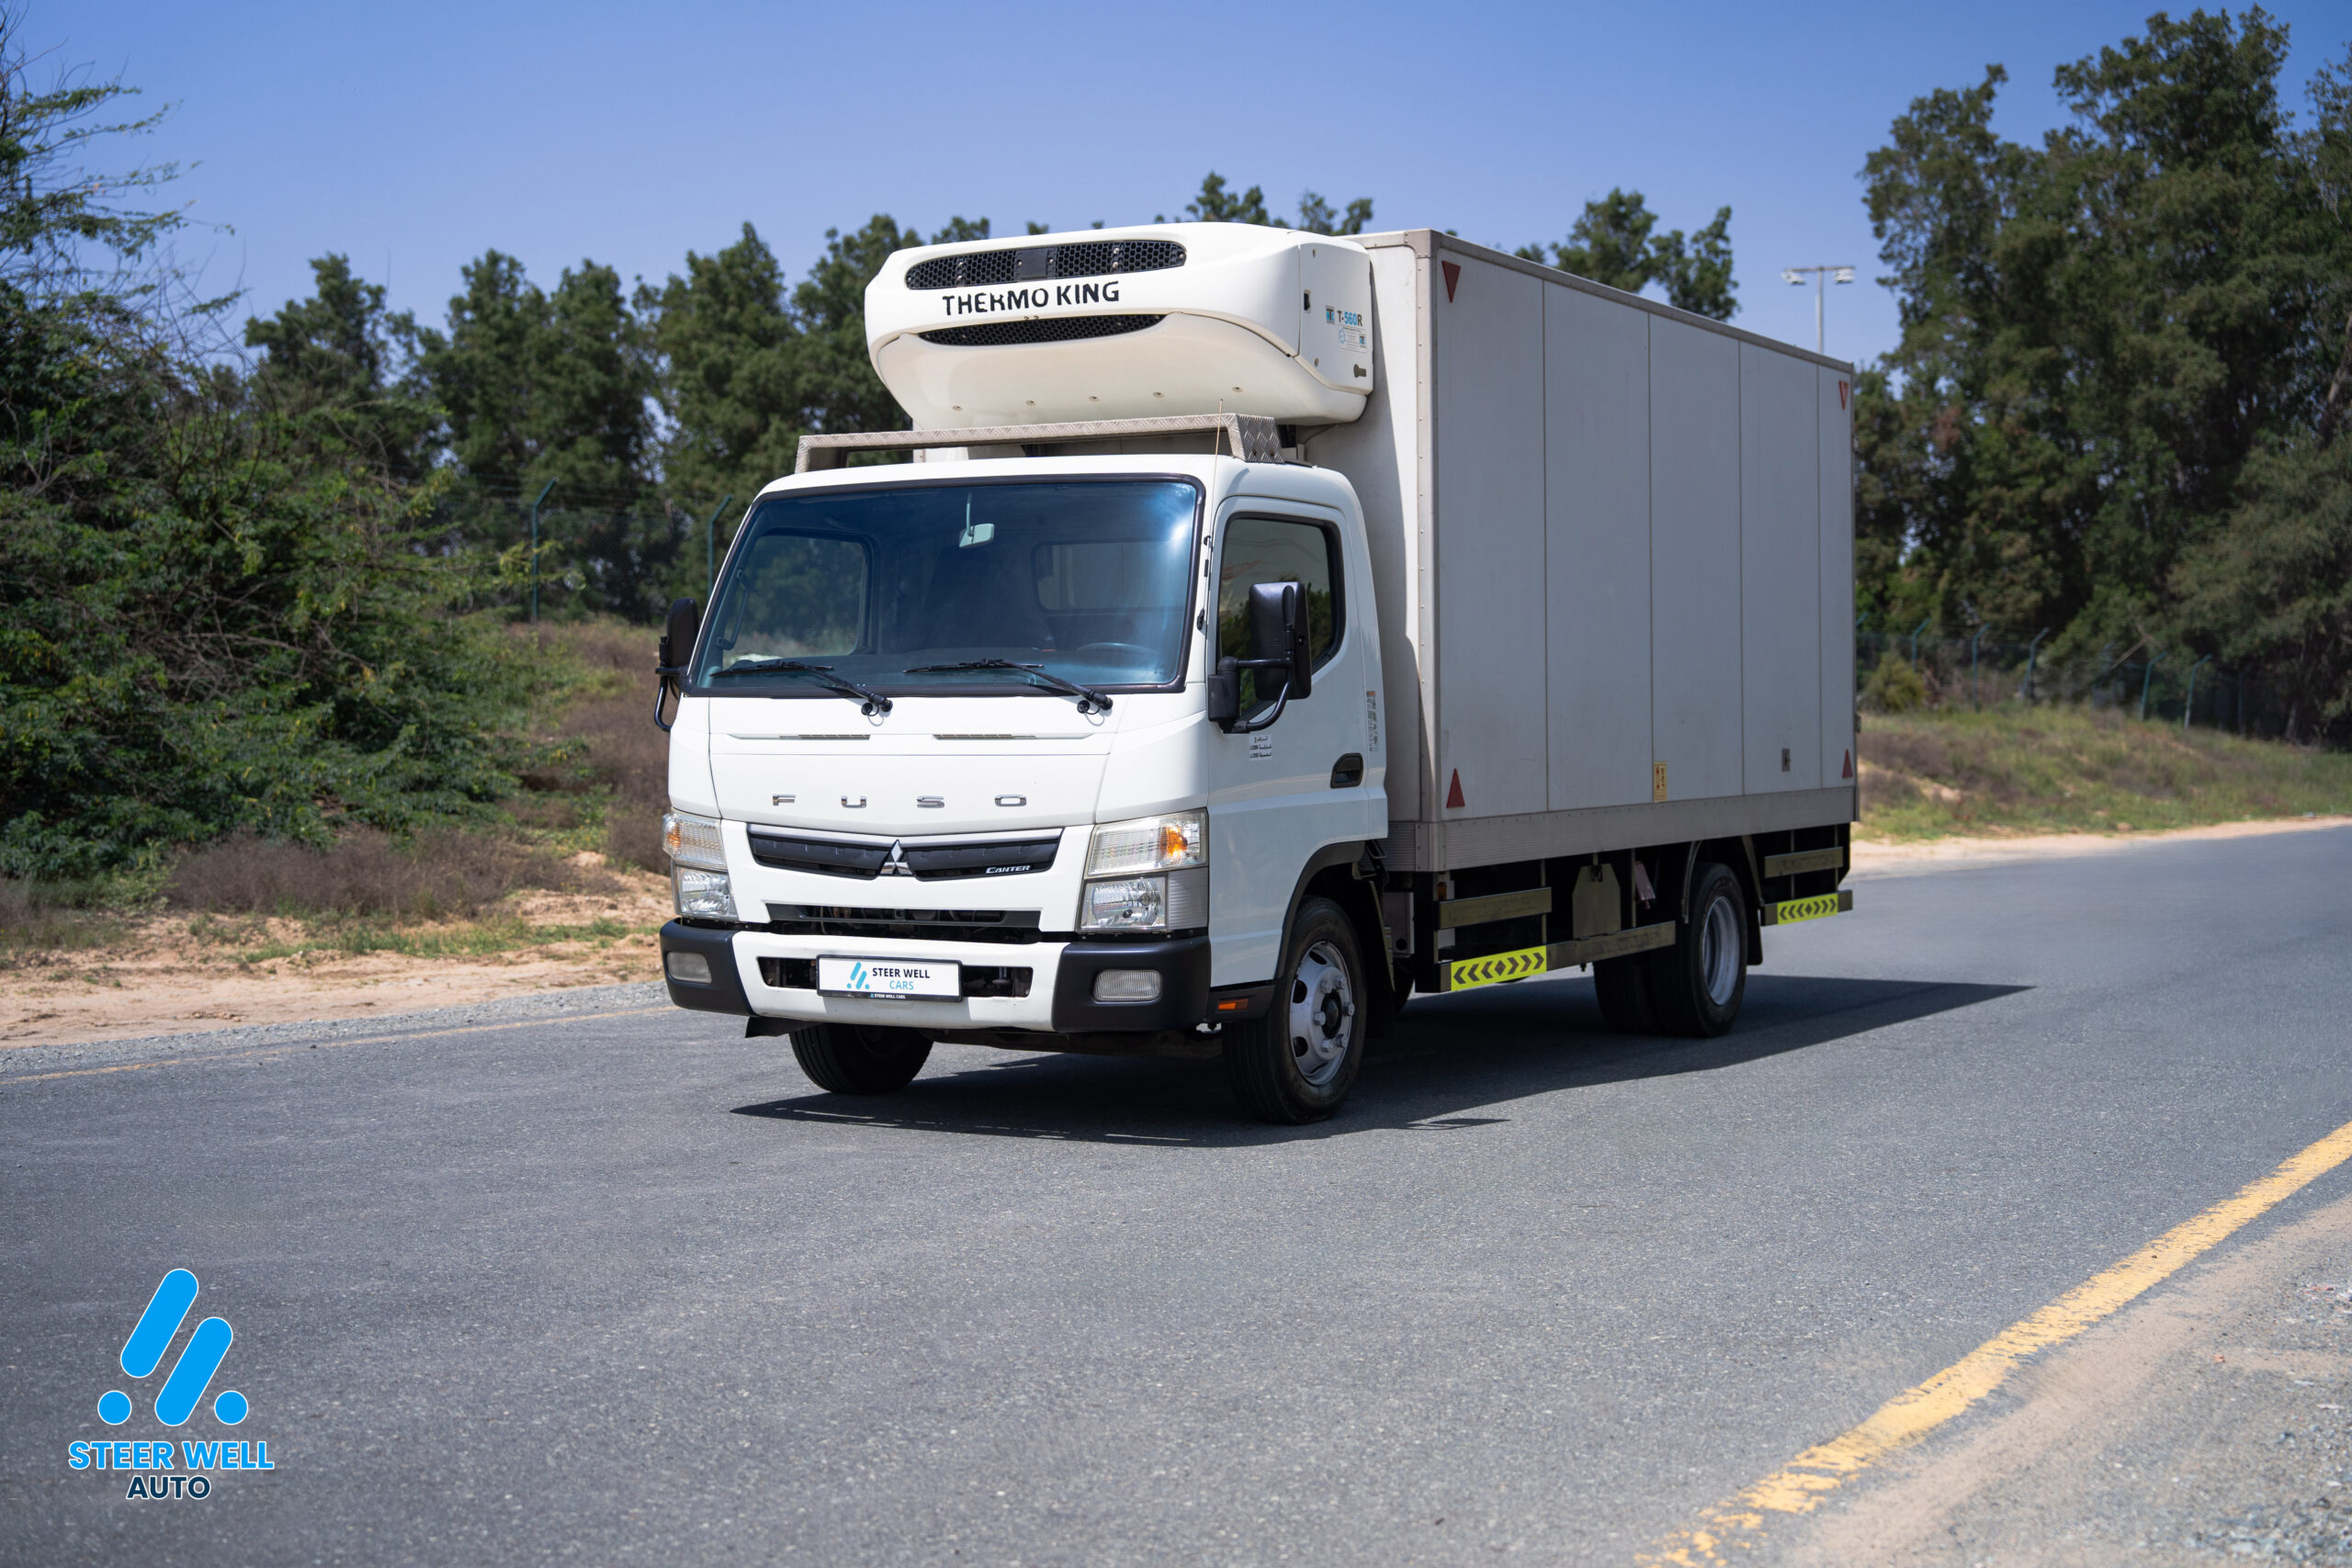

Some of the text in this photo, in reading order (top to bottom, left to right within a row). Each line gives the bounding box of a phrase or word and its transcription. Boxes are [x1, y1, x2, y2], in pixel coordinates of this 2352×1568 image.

[943, 281, 1119, 316] THERMO KING
[772, 794, 1027, 808] FUSO
[986, 864, 1031, 874] CANTER
[872, 967, 931, 979] STEER WELL
[889, 980, 914, 990] CARS
